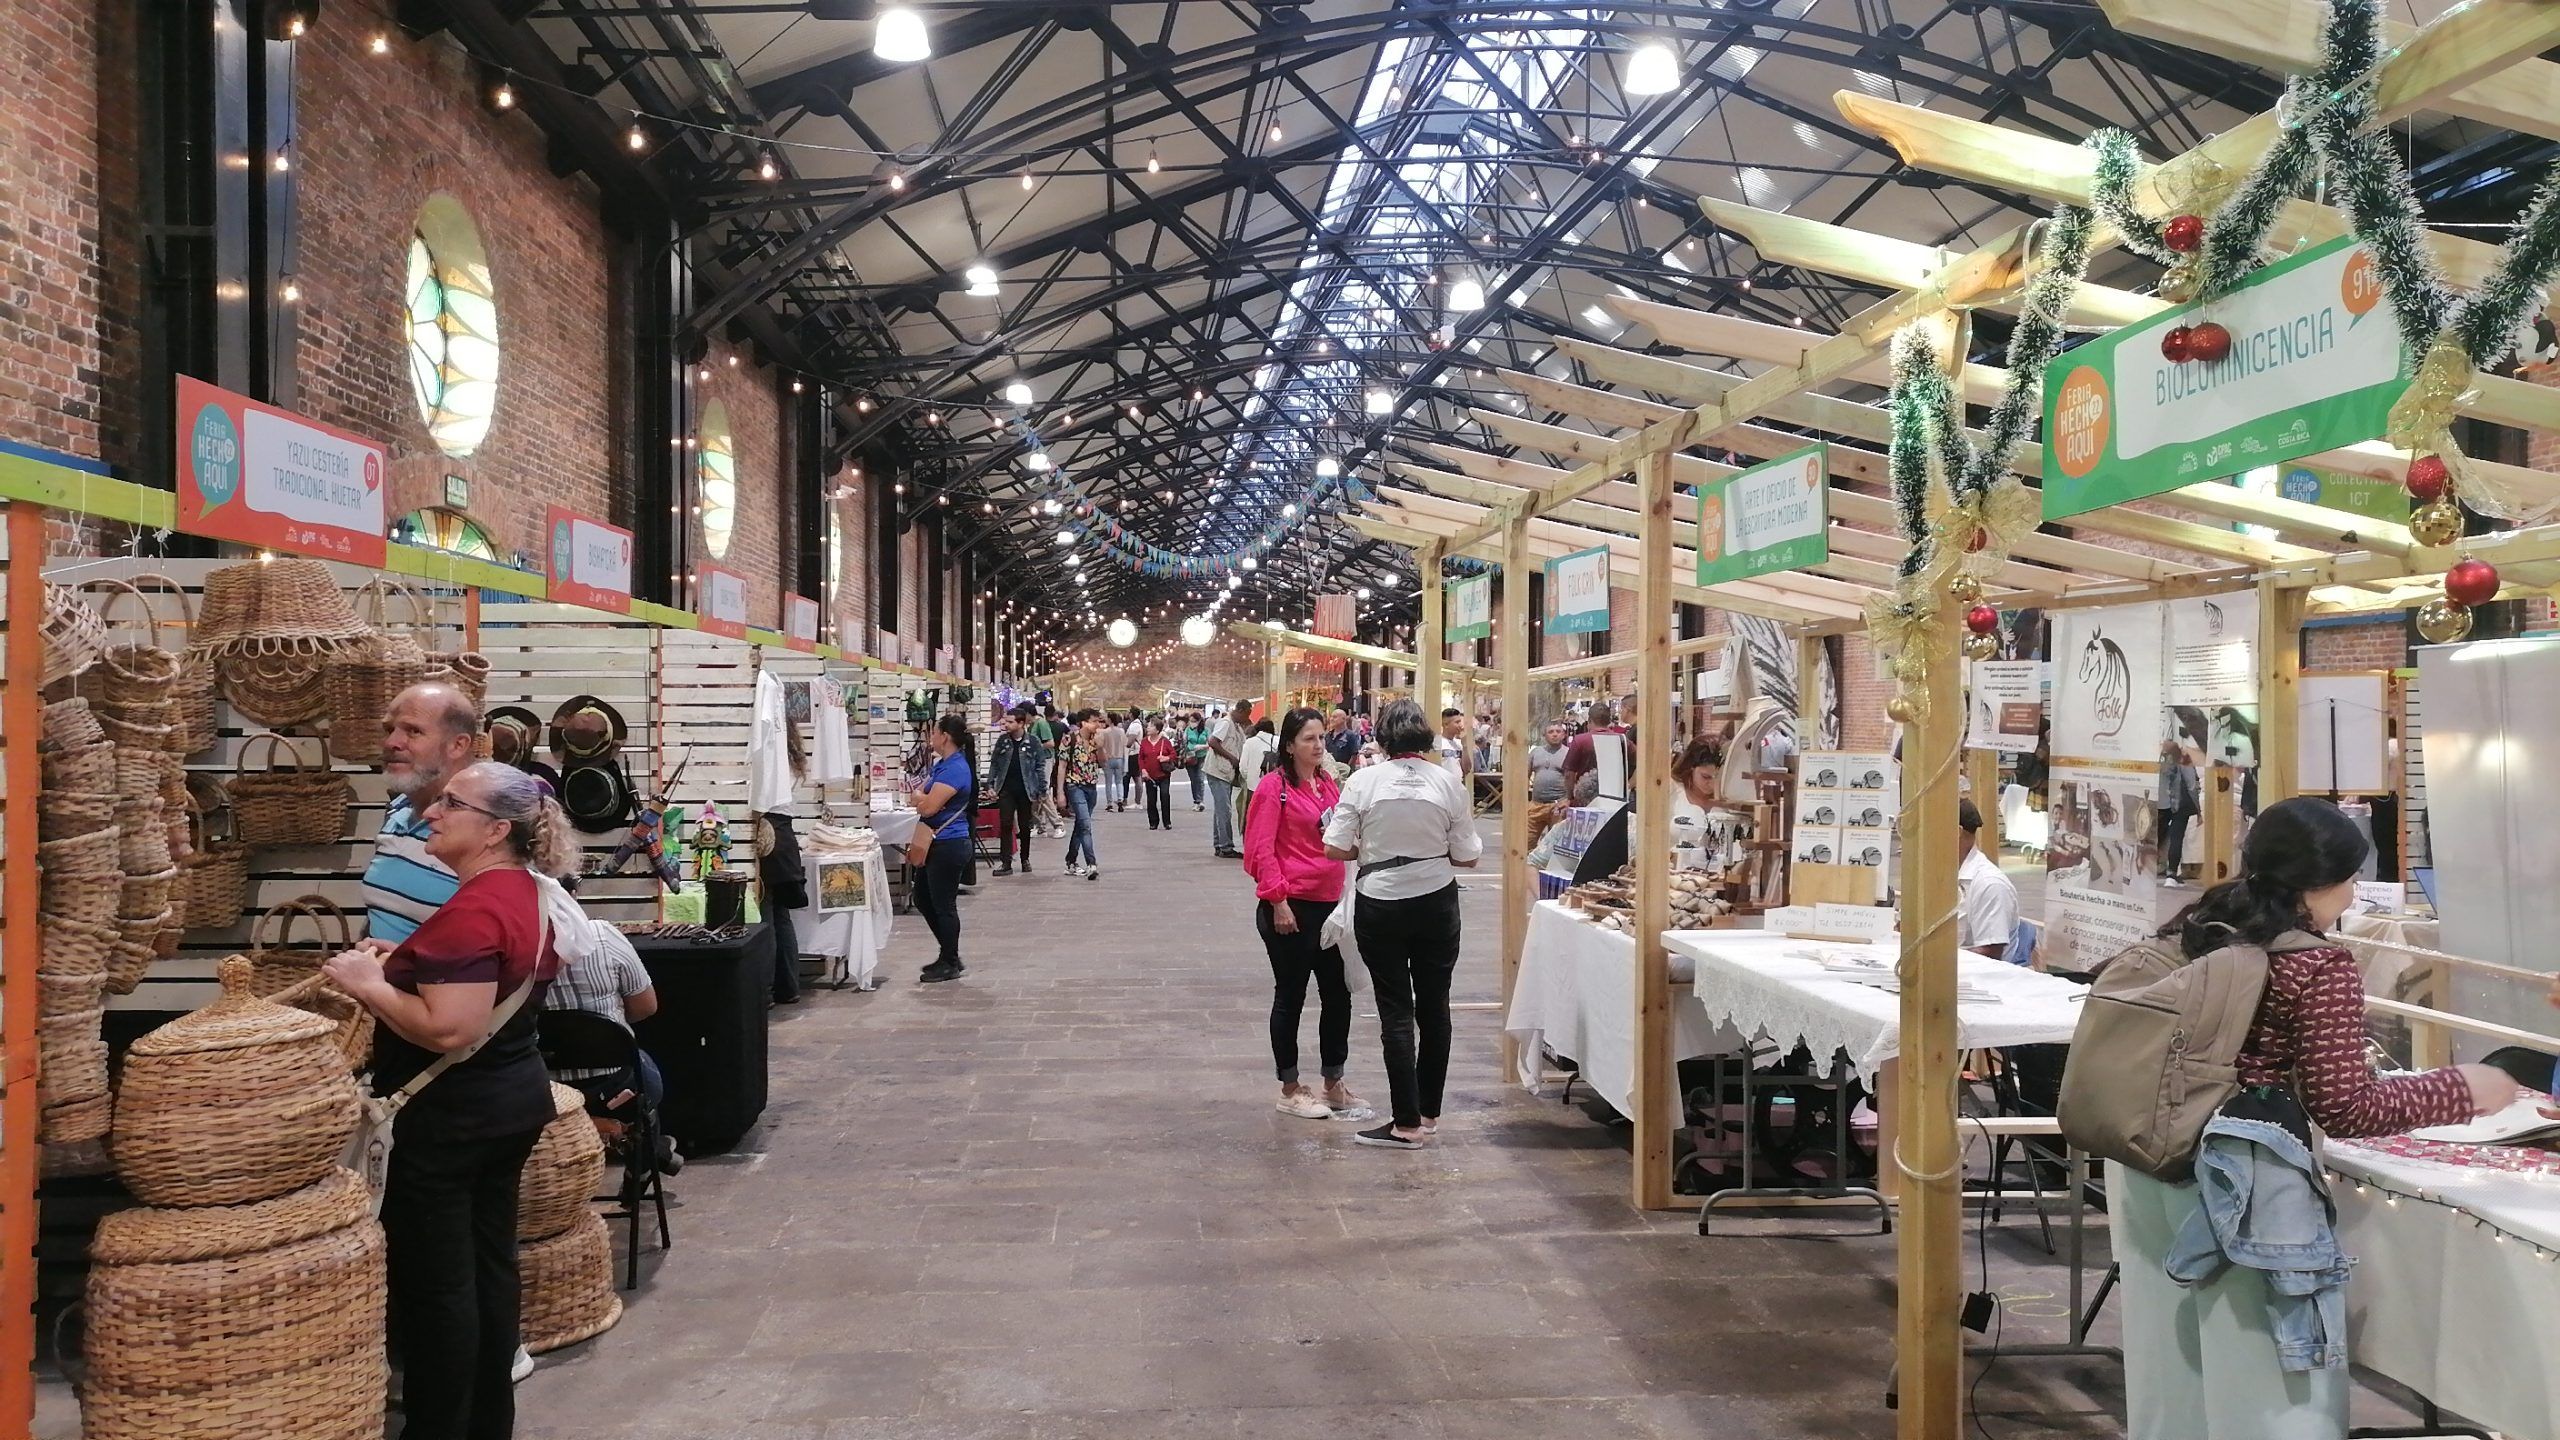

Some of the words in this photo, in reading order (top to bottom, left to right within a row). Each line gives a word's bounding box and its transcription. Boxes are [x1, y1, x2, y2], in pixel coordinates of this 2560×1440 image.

[2066, 383, 2092, 407] FERIA
[204, 416, 226, 438] FERIA
[2278, 436, 2296, 447] COSTA
[286, 440, 310, 468] YAZU
[366, 460, 377, 482] 07
[273, 466, 329, 502] TRADICIONAL
[331, 483, 362, 510] HUETAR
[1744, 487, 1760, 511] ARTE
[1788, 477, 1797, 498] DE
[2350, 492, 2371, 506] ICT
[1778, 500, 1808, 528] MODERNA
[2355, 884, 2393, 894] Regreso
[2366, 892, 2393, 902] breve
[2086, 894, 2105, 906] hecha
[2094, 917, 2124, 932] conservar
[2070, 926, 2096, 939] conocer
[2097, 934, 2109, 943] una
[2069, 939, 2080, 950] de
[2093, 944, 2102, 955] de
